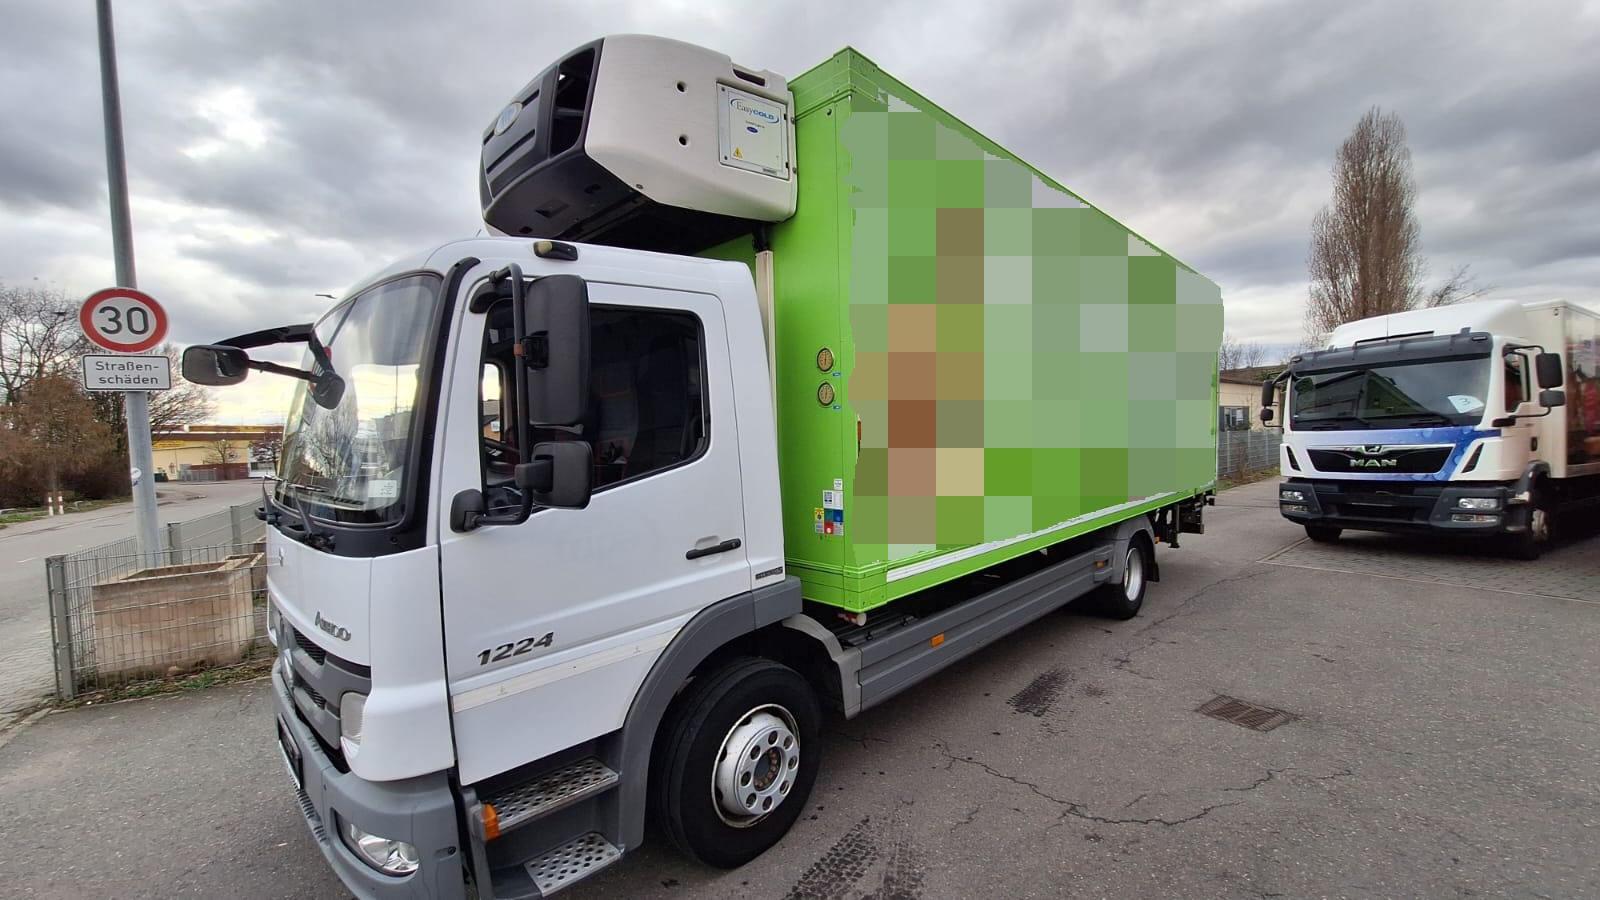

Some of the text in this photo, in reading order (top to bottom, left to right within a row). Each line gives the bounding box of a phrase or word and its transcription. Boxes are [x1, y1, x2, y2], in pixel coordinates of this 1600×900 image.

[98, 306, 150, 335] 30
[95, 361, 160, 371] Straßen-
[98, 374, 159, 385] schäden
[1349, 459, 1397, 467] MAN
[477, 631, 554, 666] 1224
